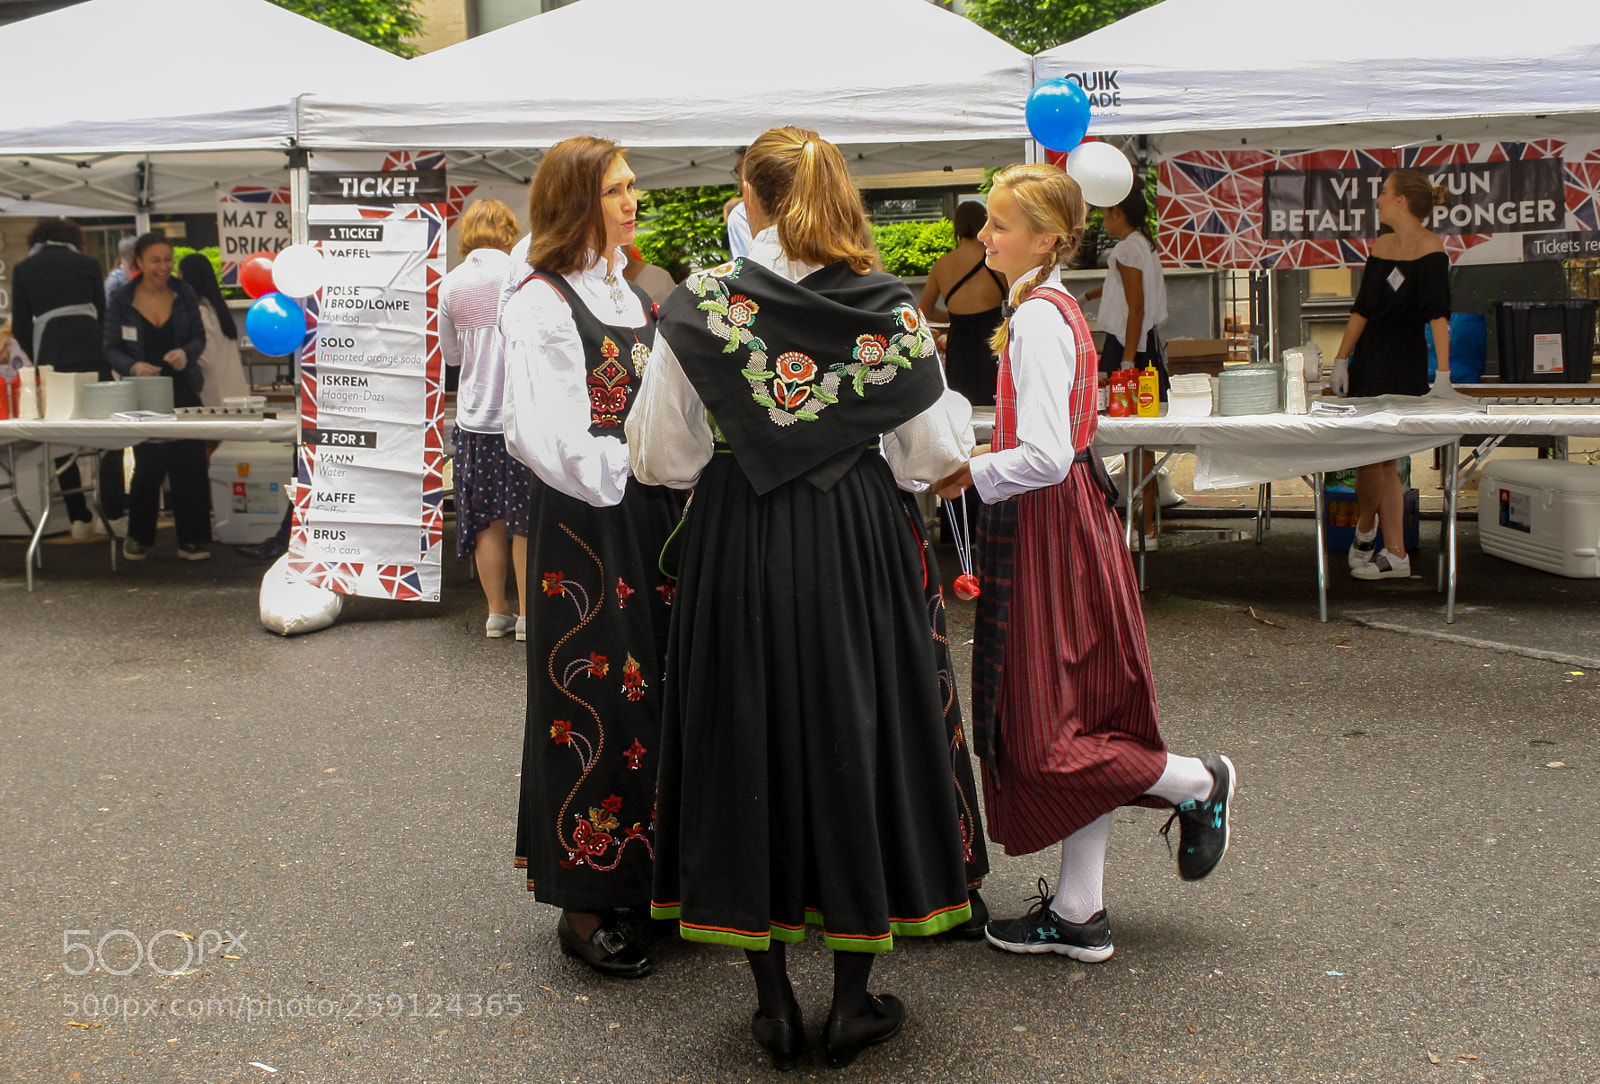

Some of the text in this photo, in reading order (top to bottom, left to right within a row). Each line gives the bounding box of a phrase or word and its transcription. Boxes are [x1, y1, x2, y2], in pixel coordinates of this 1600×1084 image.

[1089, 92, 1121, 107] ADE
[338, 176, 420, 197] TICKET
[1330, 176, 1358, 199] VI
[223, 209, 289, 229] MAT &
[1271, 199, 1556, 232] BETALT PONGER
[329, 227, 380, 239] 1 TICKET
[329, 248, 371, 259] VAFFEL
[1534, 239, 1600, 255] Tickets re
[322, 312, 360, 324] Hot dog
[320, 337, 355, 348] SOLO
[320, 351, 422, 366] Imported orange soda
[322, 375, 369, 387] ISKREM
[322, 401, 367, 414] Ice cream
[321, 432, 366, 446] 2 FOR 1
[318, 467, 347, 478] Water
[316, 491, 356, 504] KAFFE
[313, 529, 346, 541] BRUS
[339, 547, 361, 555] cans
